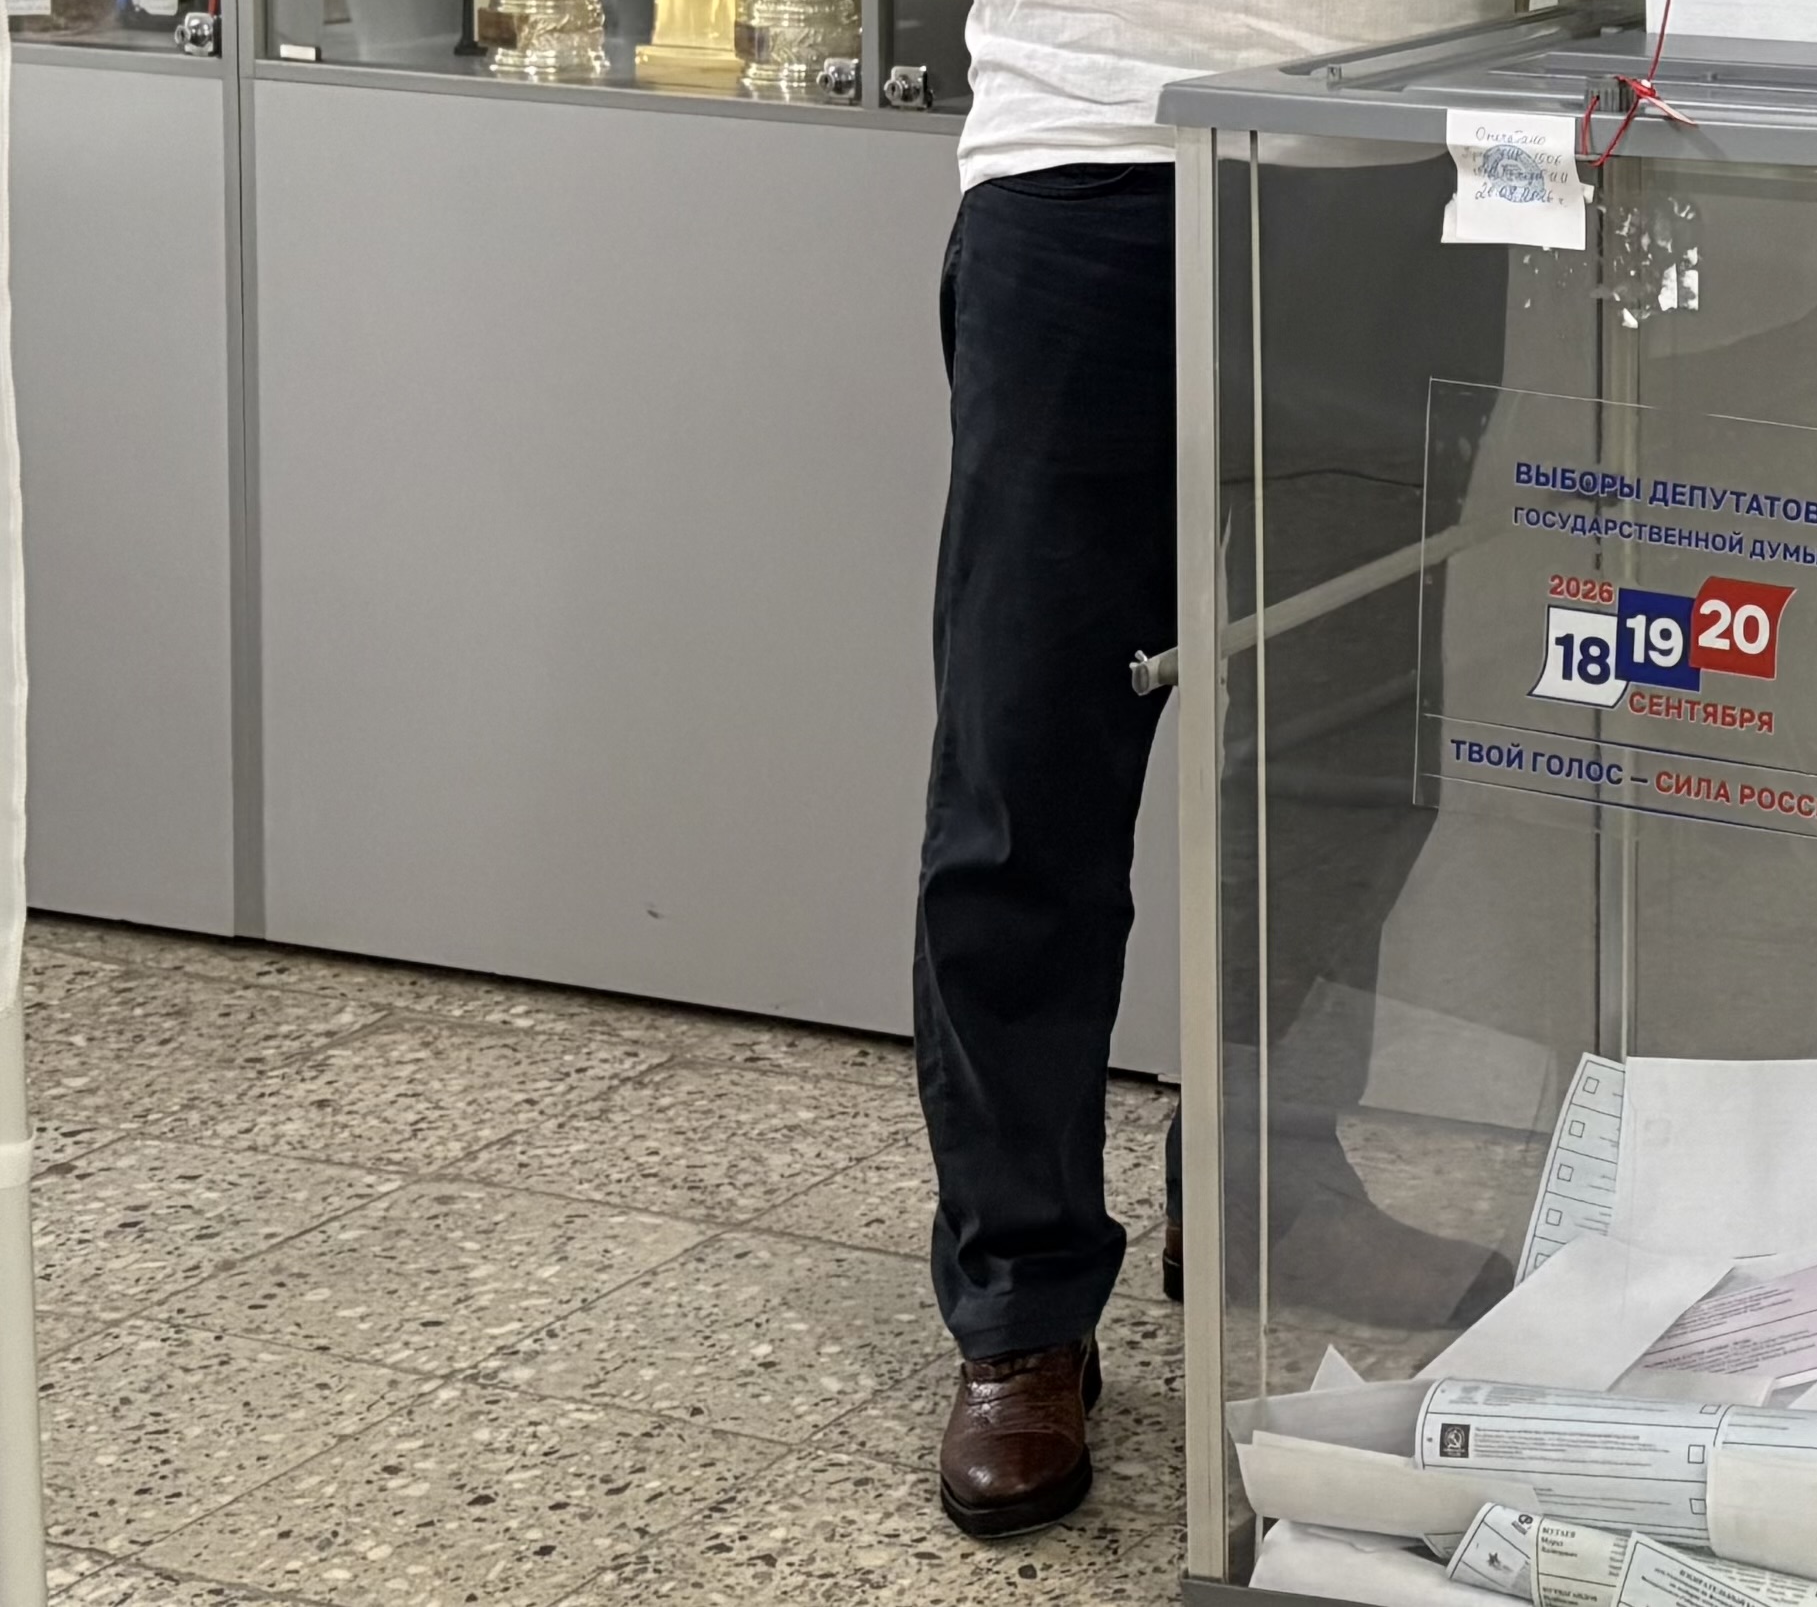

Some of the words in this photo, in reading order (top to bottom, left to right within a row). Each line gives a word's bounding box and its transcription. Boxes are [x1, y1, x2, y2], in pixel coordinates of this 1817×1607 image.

[1515, 462, 1642, 500] ВЫБОРЫ
[1513, 507, 1743, 554] ГОСУДАРСТВЕННОЙ
[1549, 574, 1614, 605] 2026
[1554, 632, 1612, 685] 18
[1626, 614, 1684, 668] 19
[1698, 599, 1770, 655] 20
[1627, 691, 1774, 734] СЕНТЯБРЯ
[1450, 738, 1524, 771] ТВОЙ
[1531, 751, 1624, 785] ГОЛОС
[1655, 771, 1732, 805] СИЛА
